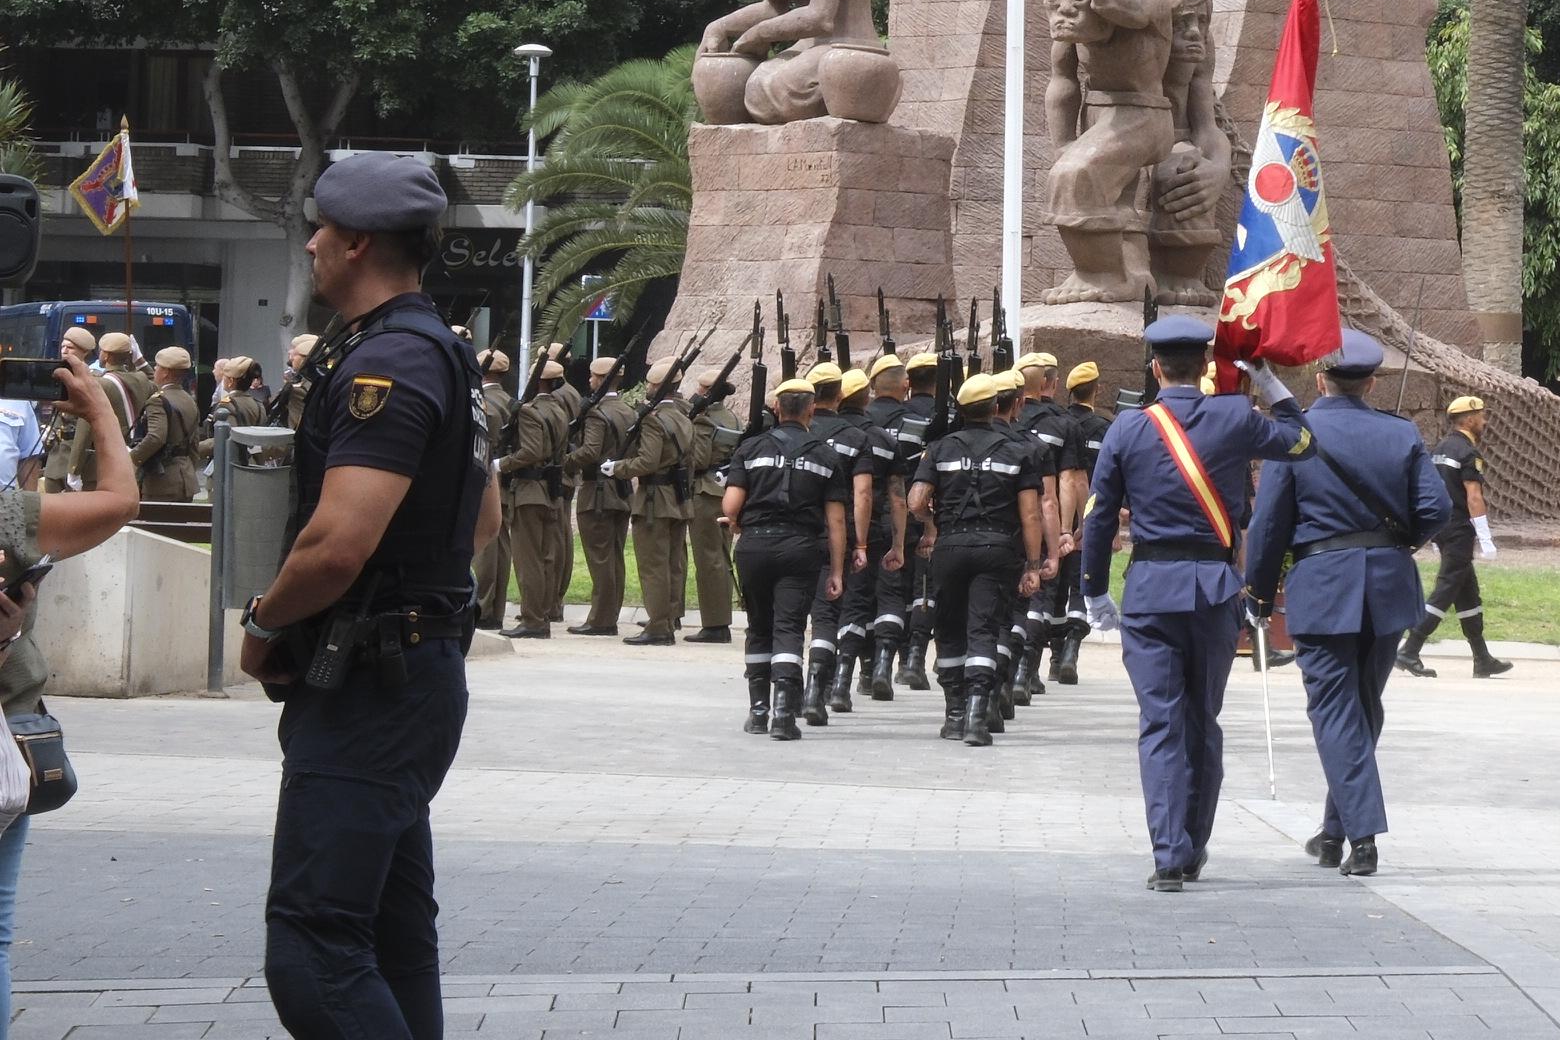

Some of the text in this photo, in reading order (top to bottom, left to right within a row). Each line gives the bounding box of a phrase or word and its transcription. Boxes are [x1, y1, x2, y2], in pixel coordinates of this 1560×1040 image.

[146, 306, 174, 316] 10U-15
[774, 454, 805, 470] UE
[961, 456, 992, 471] UE
